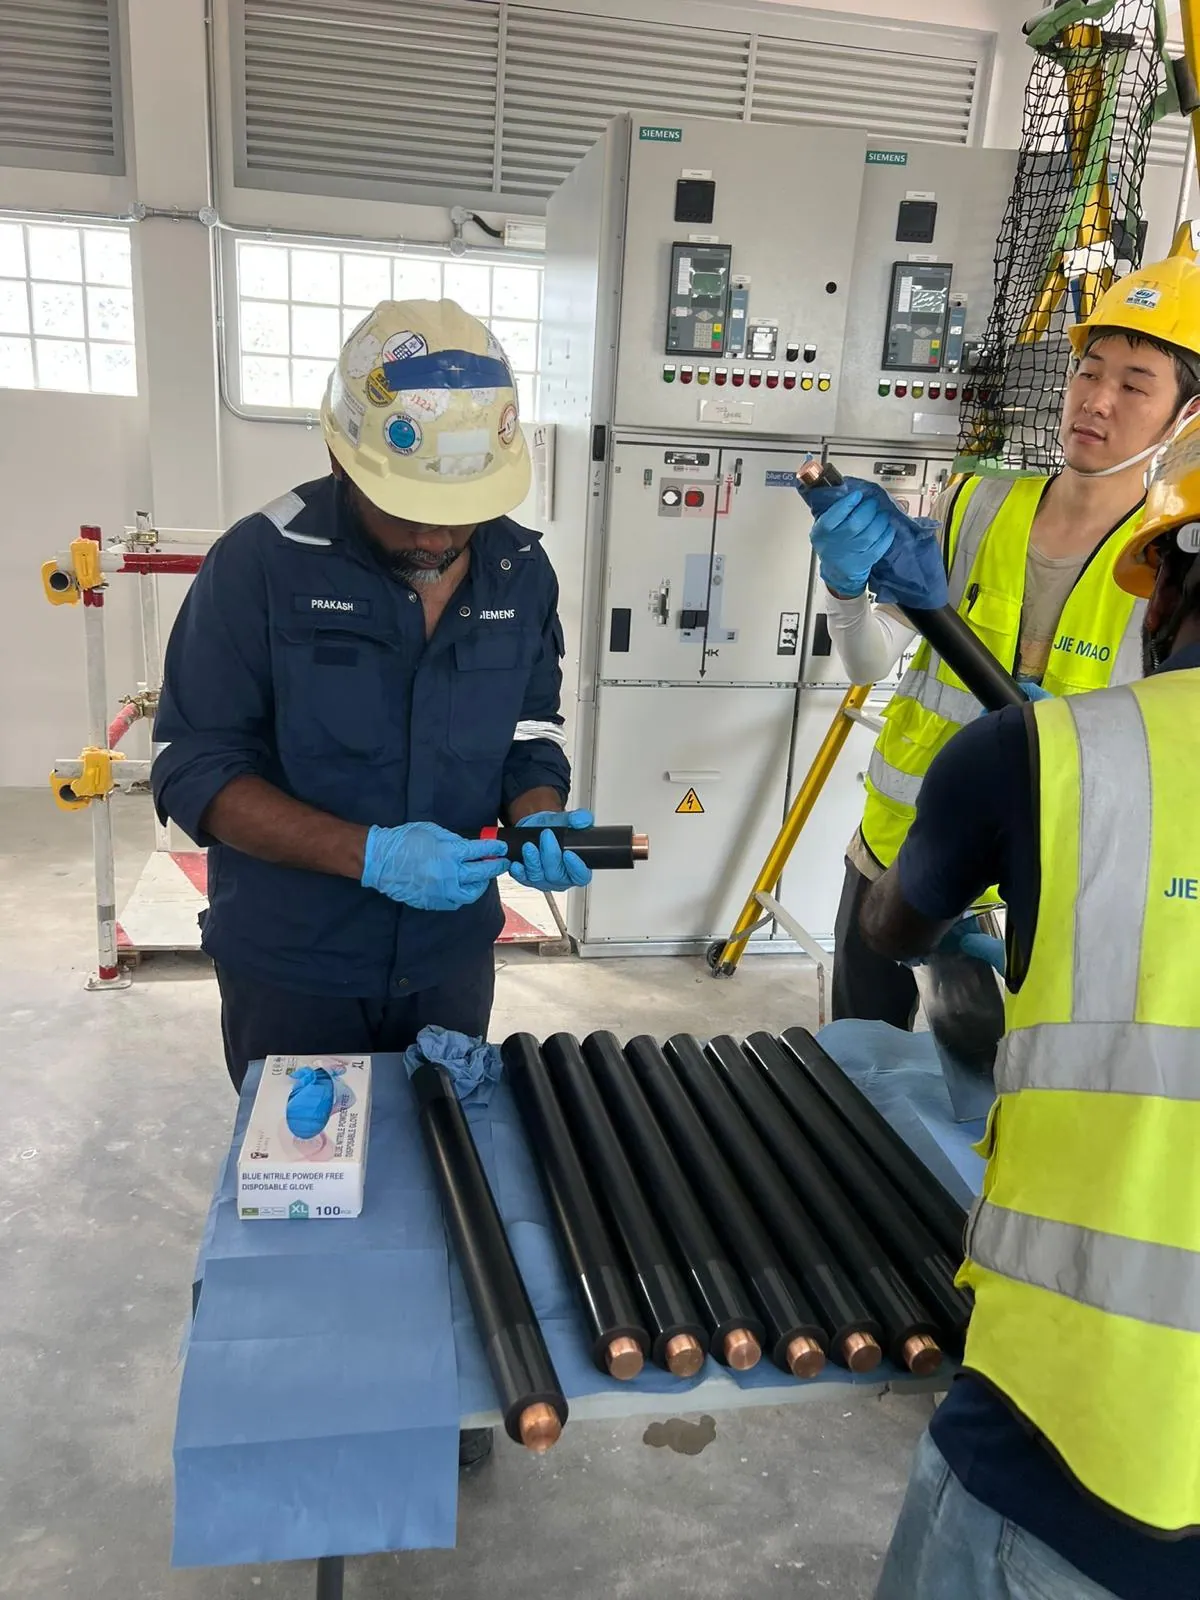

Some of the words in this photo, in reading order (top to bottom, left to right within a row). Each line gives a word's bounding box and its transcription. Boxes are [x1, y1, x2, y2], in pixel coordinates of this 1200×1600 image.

[641, 128, 680, 139] SIEMENS
[868, 152, 906, 163] SIEMENS
[311, 599, 354, 612] PRAKASH
[1054, 635, 1075, 652] JIE
[1075, 640, 1110, 661] MAO
[1163, 877, 1198, 900] JIE
[242, 1172, 262, 1180] BLUE
[263, 1172, 290, 1180] NITRILE
[292, 1172, 323, 1180] POWDER
[325, 1172, 344, 1180] FREE
[241, 1183, 288, 1191] DISPOSABLE
[289, 1183, 314, 1191] GLOVE
[291, 1205, 307, 1214] XL
[316, 1206, 340, 1216] 100
